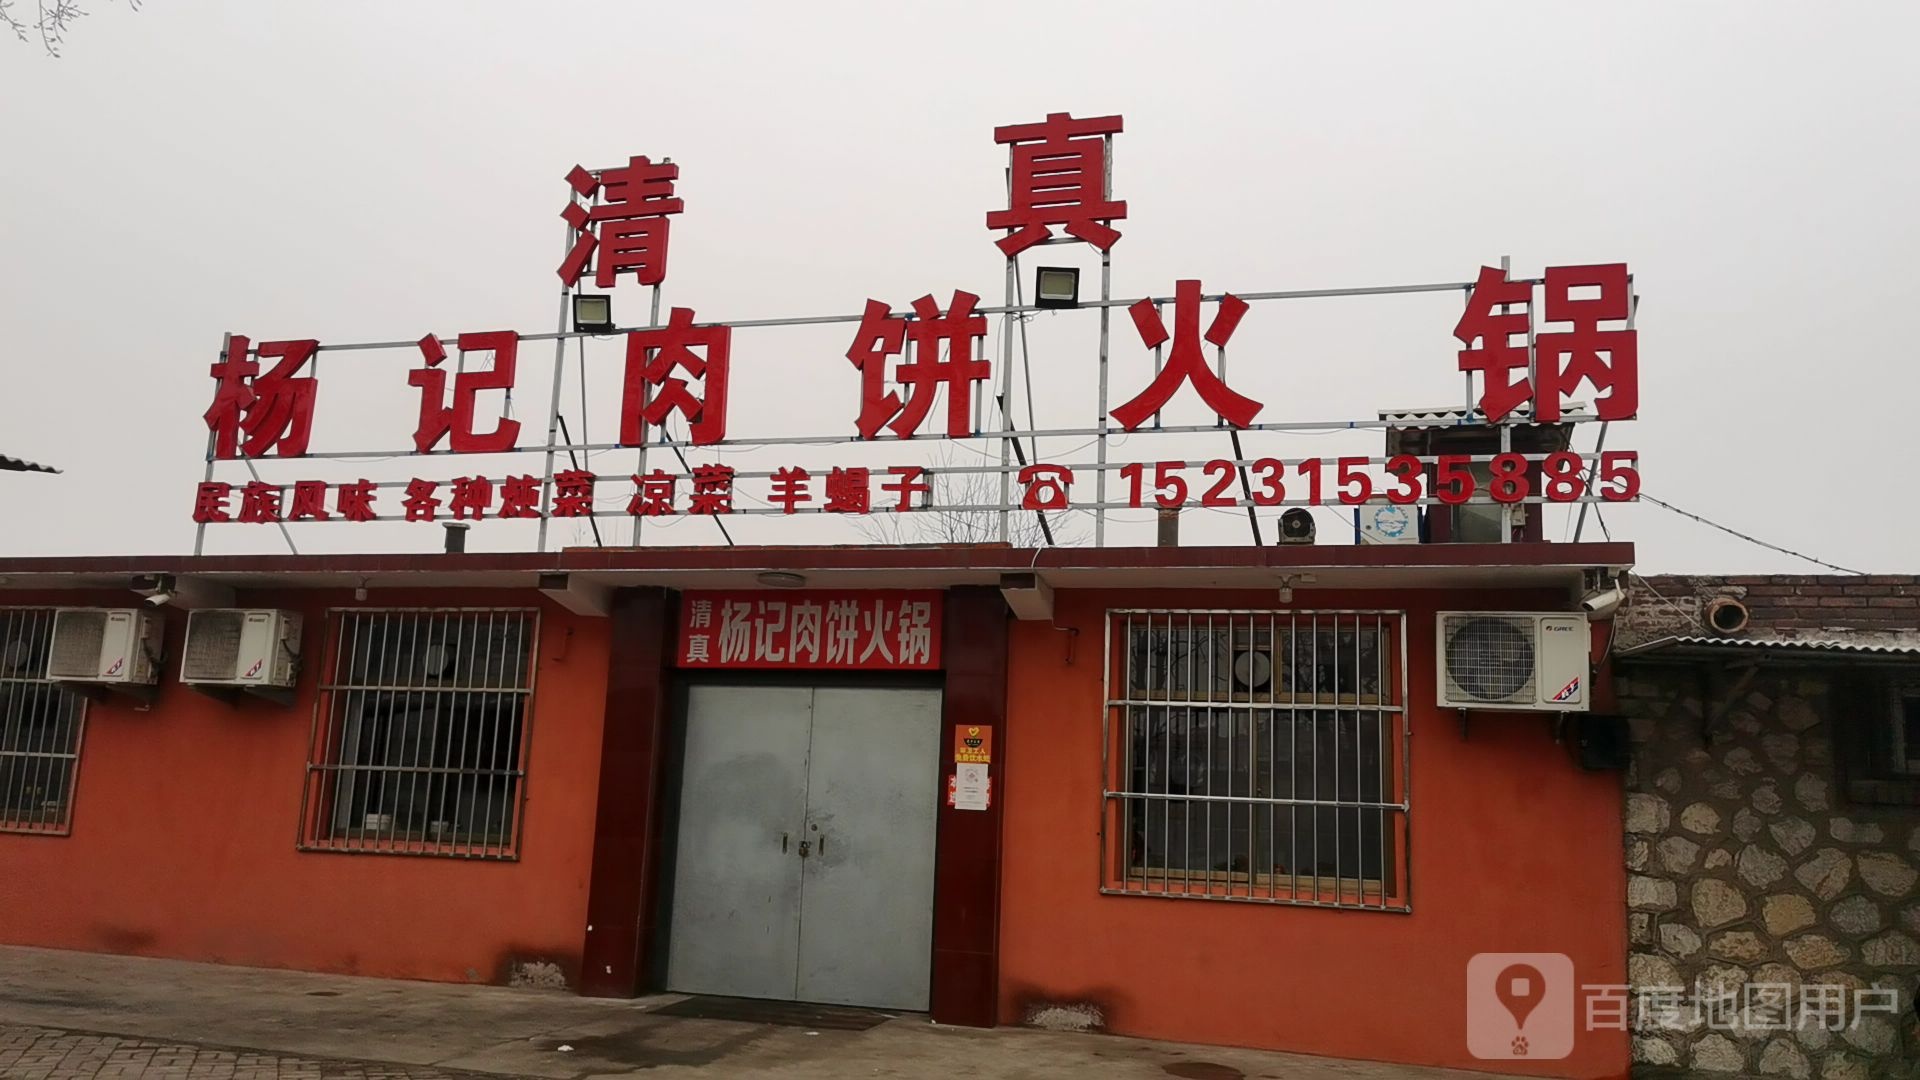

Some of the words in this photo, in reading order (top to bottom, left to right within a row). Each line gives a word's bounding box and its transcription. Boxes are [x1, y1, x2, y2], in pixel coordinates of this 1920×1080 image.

[204, 264, 1638, 459] 杨记肉饼火锅
[194, 479, 376, 523] 民族风味
[404, 473, 593, 522] 各种炖菜
[628, 464, 733, 517] 凉菜
[768, 466, 929, 515] 羊蝎子
[1120, 451, 1641, 510] 15231535885
[687, 600, 713, 663] 清真
[718, 599, 932, 665] 杨记肉饼火锅
